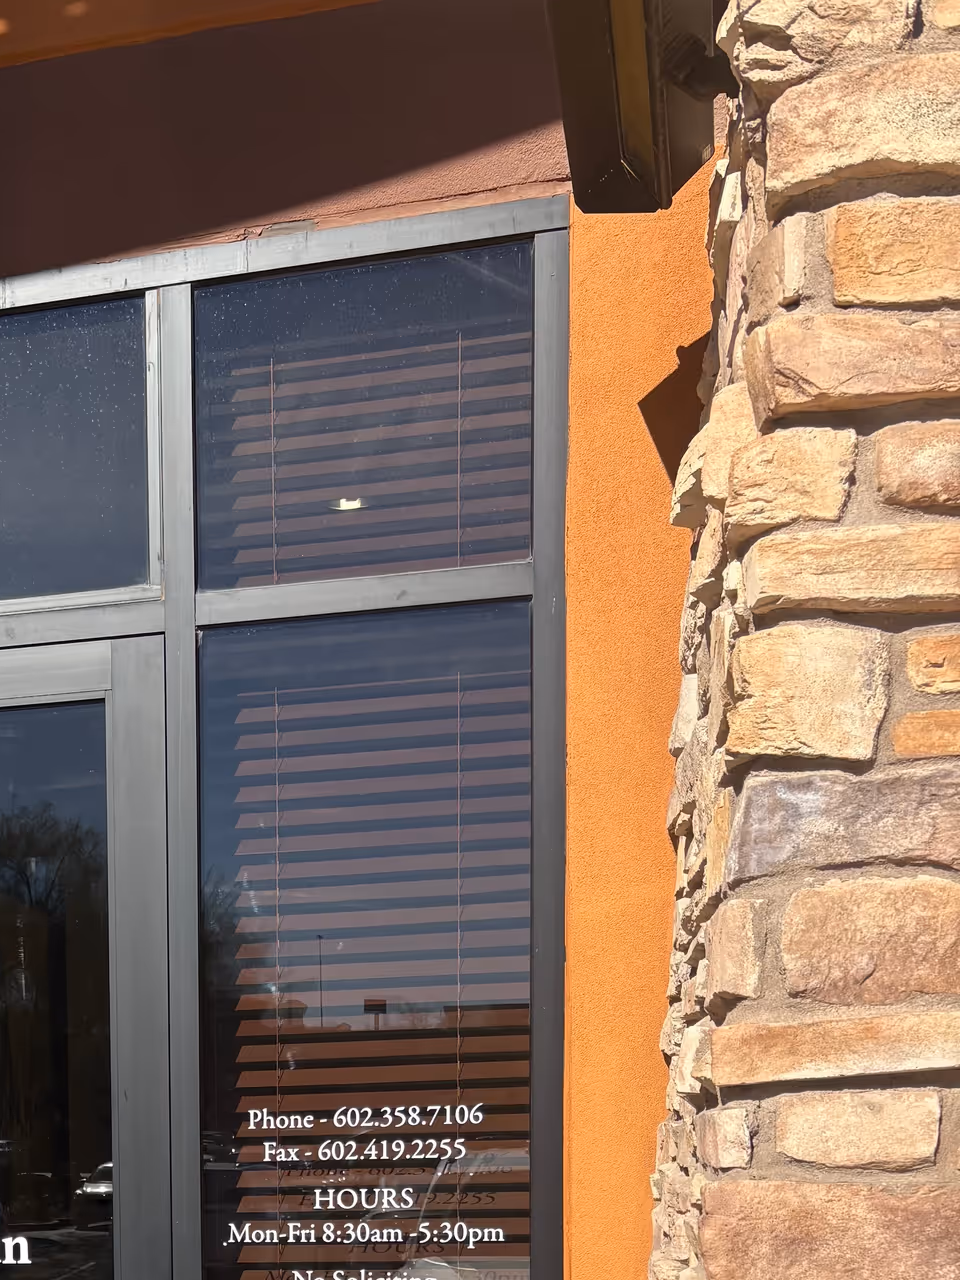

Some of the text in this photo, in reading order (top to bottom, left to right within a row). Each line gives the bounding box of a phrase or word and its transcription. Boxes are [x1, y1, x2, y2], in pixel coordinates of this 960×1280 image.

[247, 1107, 315, 1130] Phone
[333, 1103, 484, 1128] 602.358.7106
[262, 1141, 300, 1162] Fax
[317, 1138, 467, 1161] 602.419.2255
[313, 1187, 414, 1210] HOURS
[227, 1222, 317, 1243] Mon-Fri
[322, 1222, 404, 1244] 8:30am
